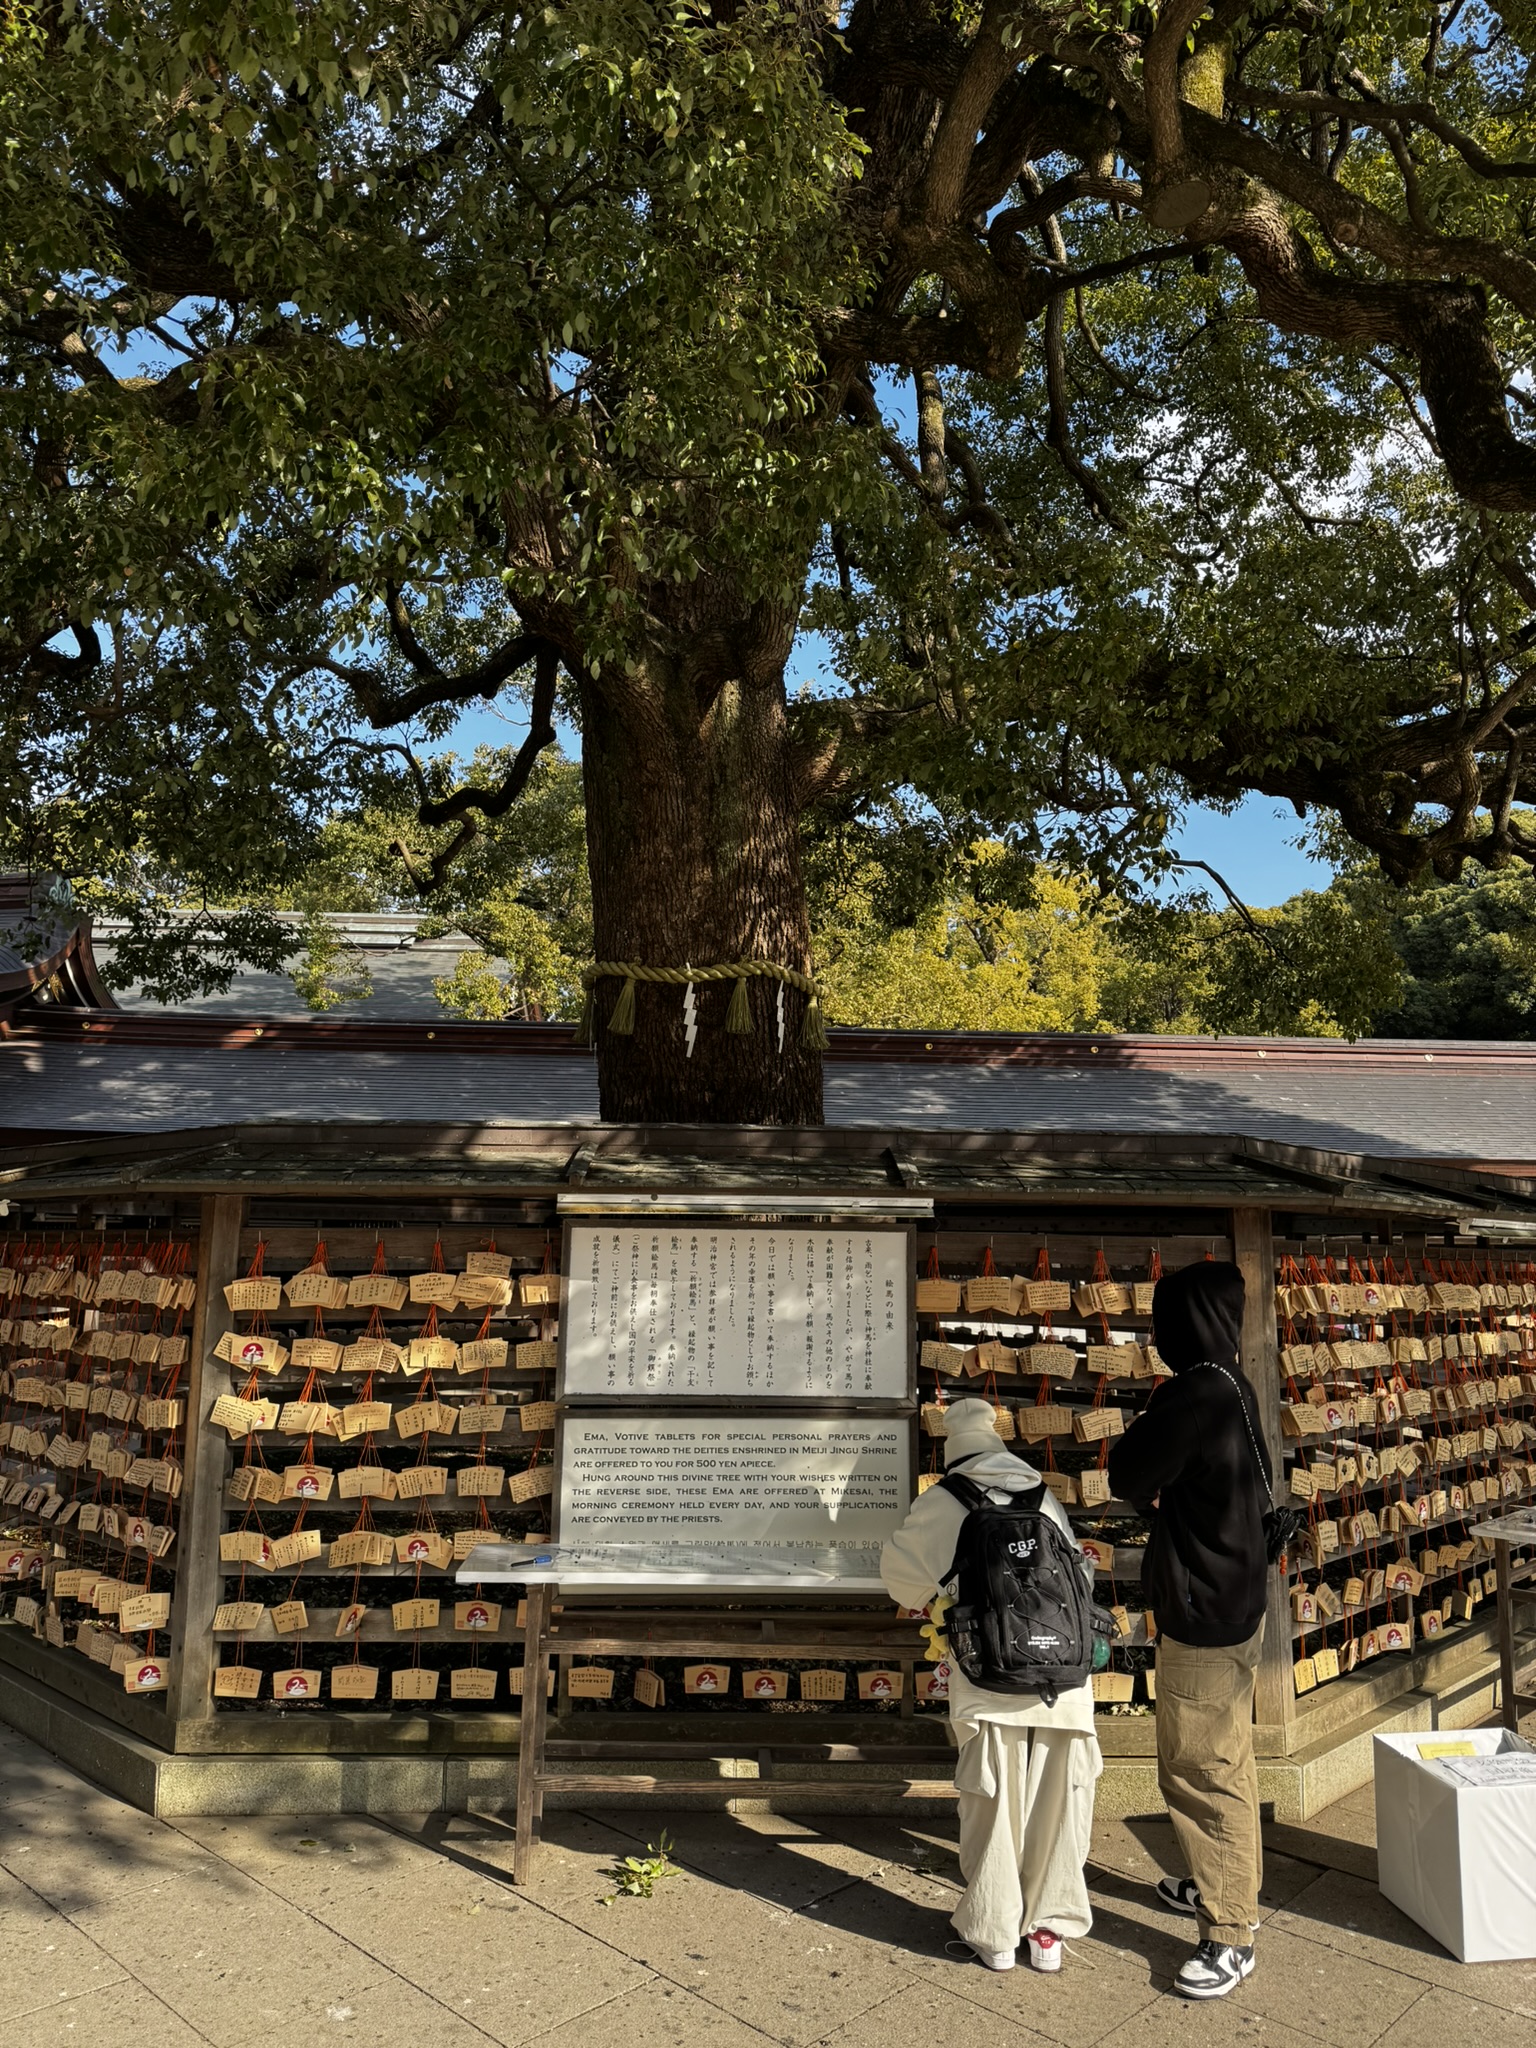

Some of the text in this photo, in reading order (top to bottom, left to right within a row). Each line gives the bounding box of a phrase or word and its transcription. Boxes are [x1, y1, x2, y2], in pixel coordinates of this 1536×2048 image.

[787, 1237, 795, 1281] なりました。
[728, 1236, 737, 1328] されるようになりました。
[885, 1279, 894, 1331] 絵馬の由来
[583, 1432, 609, 1442] EMA,
[614, 1432, 649, 1441] VOTIVE
[654, 1433, 696, 1441] TABLETS
[701, 1433, 721, 1441] FOR
[726, 1433, 767, 1441] SPECIAL
[772, 1433, 823, 1441] PERSONAL
[828, 1433, 871, 1441] PRAYERS
[573, 1445, 898, 1455] GRATITUDE TOWARD THE DEITIES ENSHRINED IN MEIJI JINGU SHRINE
[573, 1459, 776, 1469] ARE OFFERED TO YOU FOR 500 YEN APIECE.
[582, 1473, 898, 1483] HUNG AROUND THIS DIVINE TREE WITH YOUR WISHES WRITTEN ON
[571, 1486, 898, 1497] THE REVERSE SIDE, THESE EMA ARE OFFERED AT MIKESAI, THE
[571, 1501, 898, 1510] MORNING CEREMONY HELD EVERY DAY, AND YOUR SUPPLICATIONS
[570, 1515, 723, 1524] ARE CONVEYED BY THE PRIESTS.
